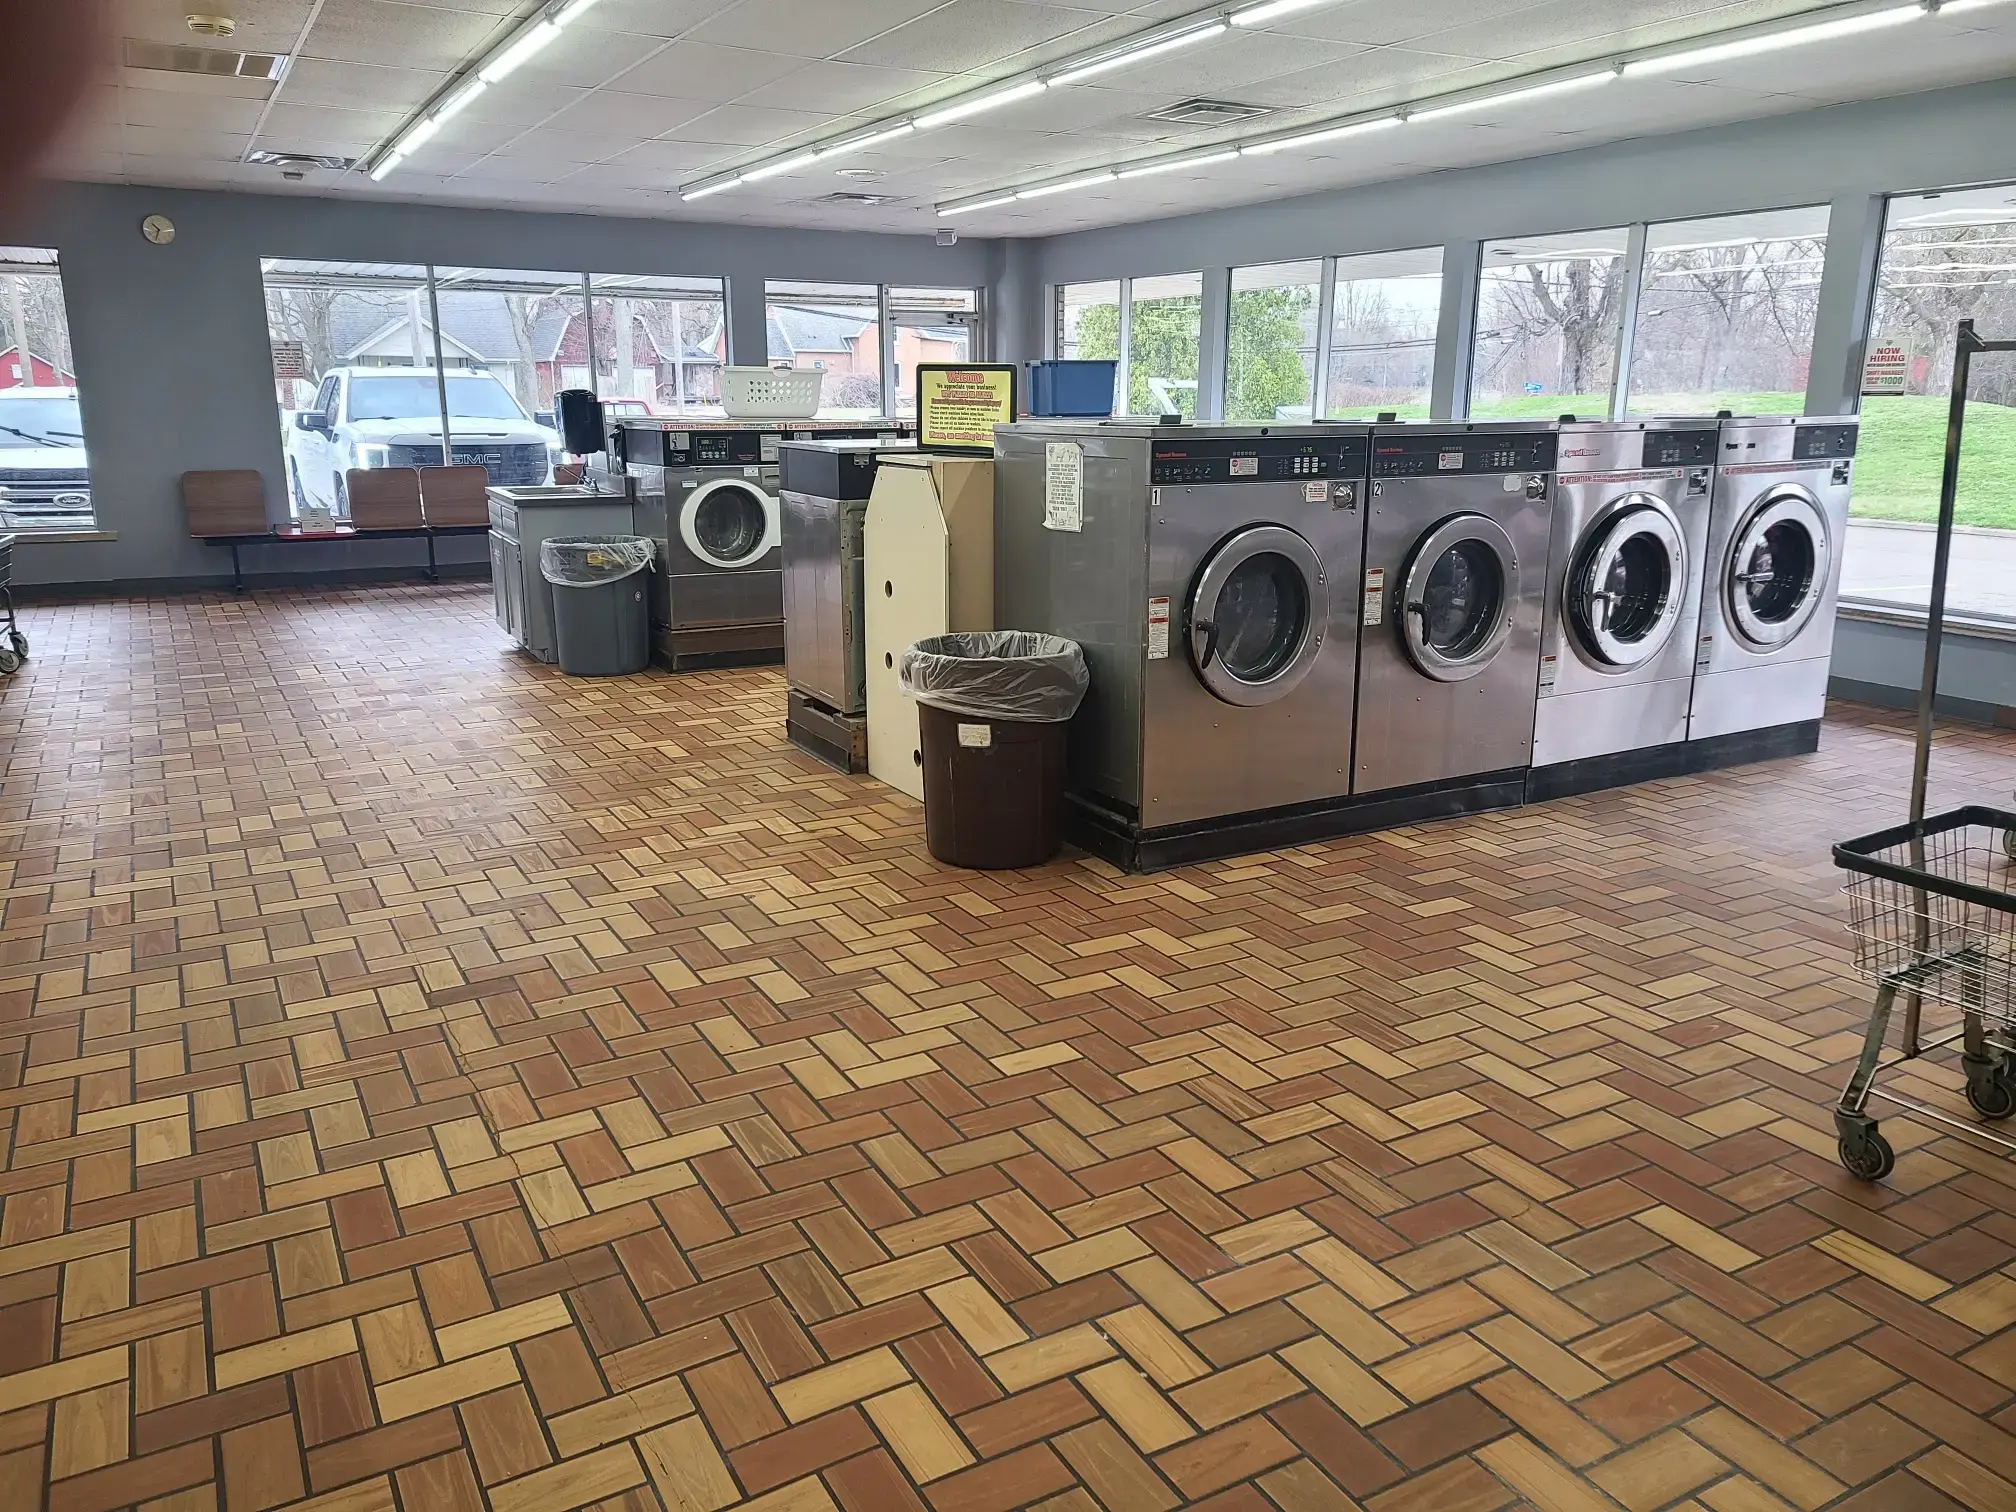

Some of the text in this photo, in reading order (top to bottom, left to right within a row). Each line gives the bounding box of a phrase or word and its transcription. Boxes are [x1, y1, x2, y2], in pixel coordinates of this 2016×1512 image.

[945, 371, 984, 384] Welcome
[451, 453, 501, 464] GMC
[1566, 475, 1593, 484] ATTENTION:
[1374, 481, 1381, 497] 2
[1153, 489, 1158, 505] 1
